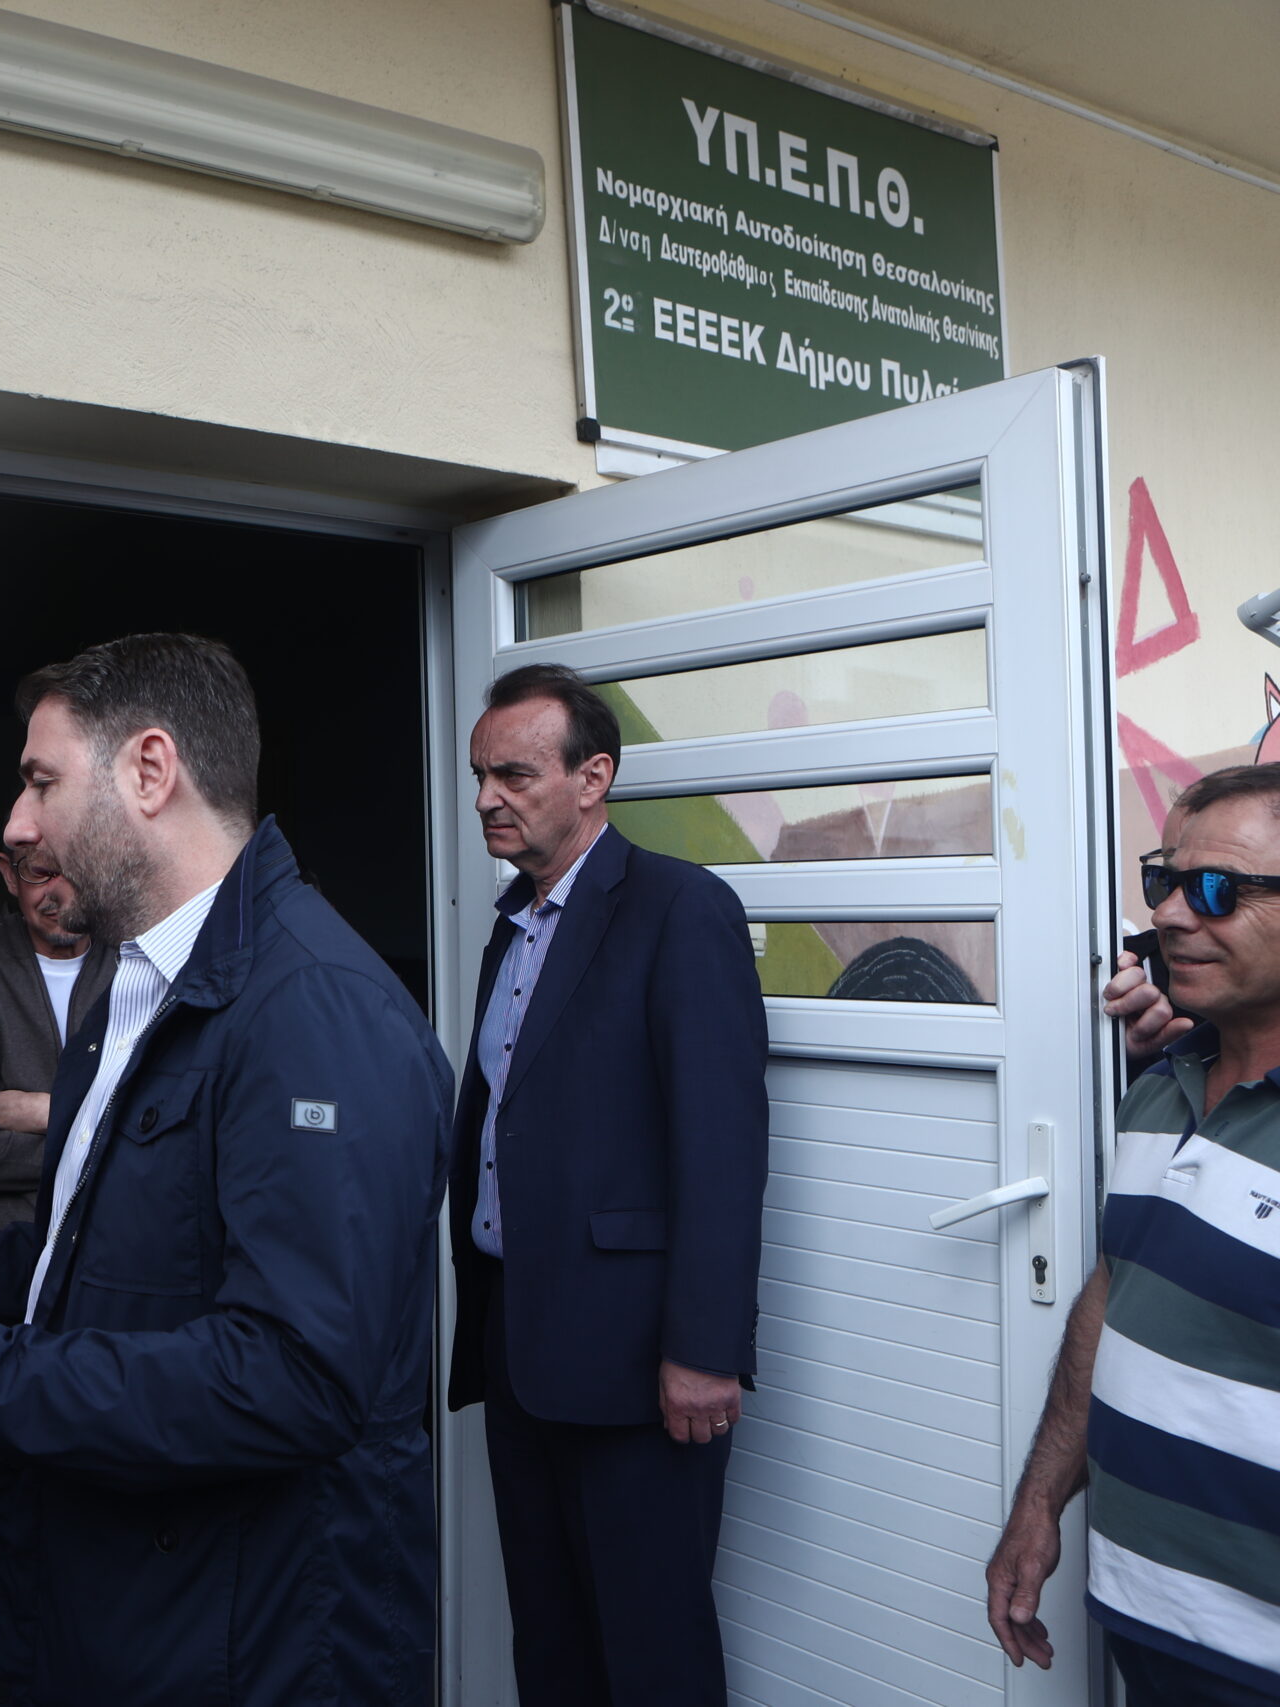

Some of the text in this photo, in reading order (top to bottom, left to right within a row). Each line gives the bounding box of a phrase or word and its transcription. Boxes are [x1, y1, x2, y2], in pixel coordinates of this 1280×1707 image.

[682, 97, 925, 235] ΥΠ.Ε.Π.Θ.
[596, 166, 995, 315] Νομαρχιακή Αυτοδιοίκηση Θεσσαλονίκης
[653, 297, 767, 366] ΕΕΕΕΚ
[776, 331, 871, 391] Δήμου
[784, 268, 869, 323] Εκπαίδευσης
[871, 295, 940, 343] Ανατολικής
[942, 315, 1000, 360] Θεσ/νίκης
